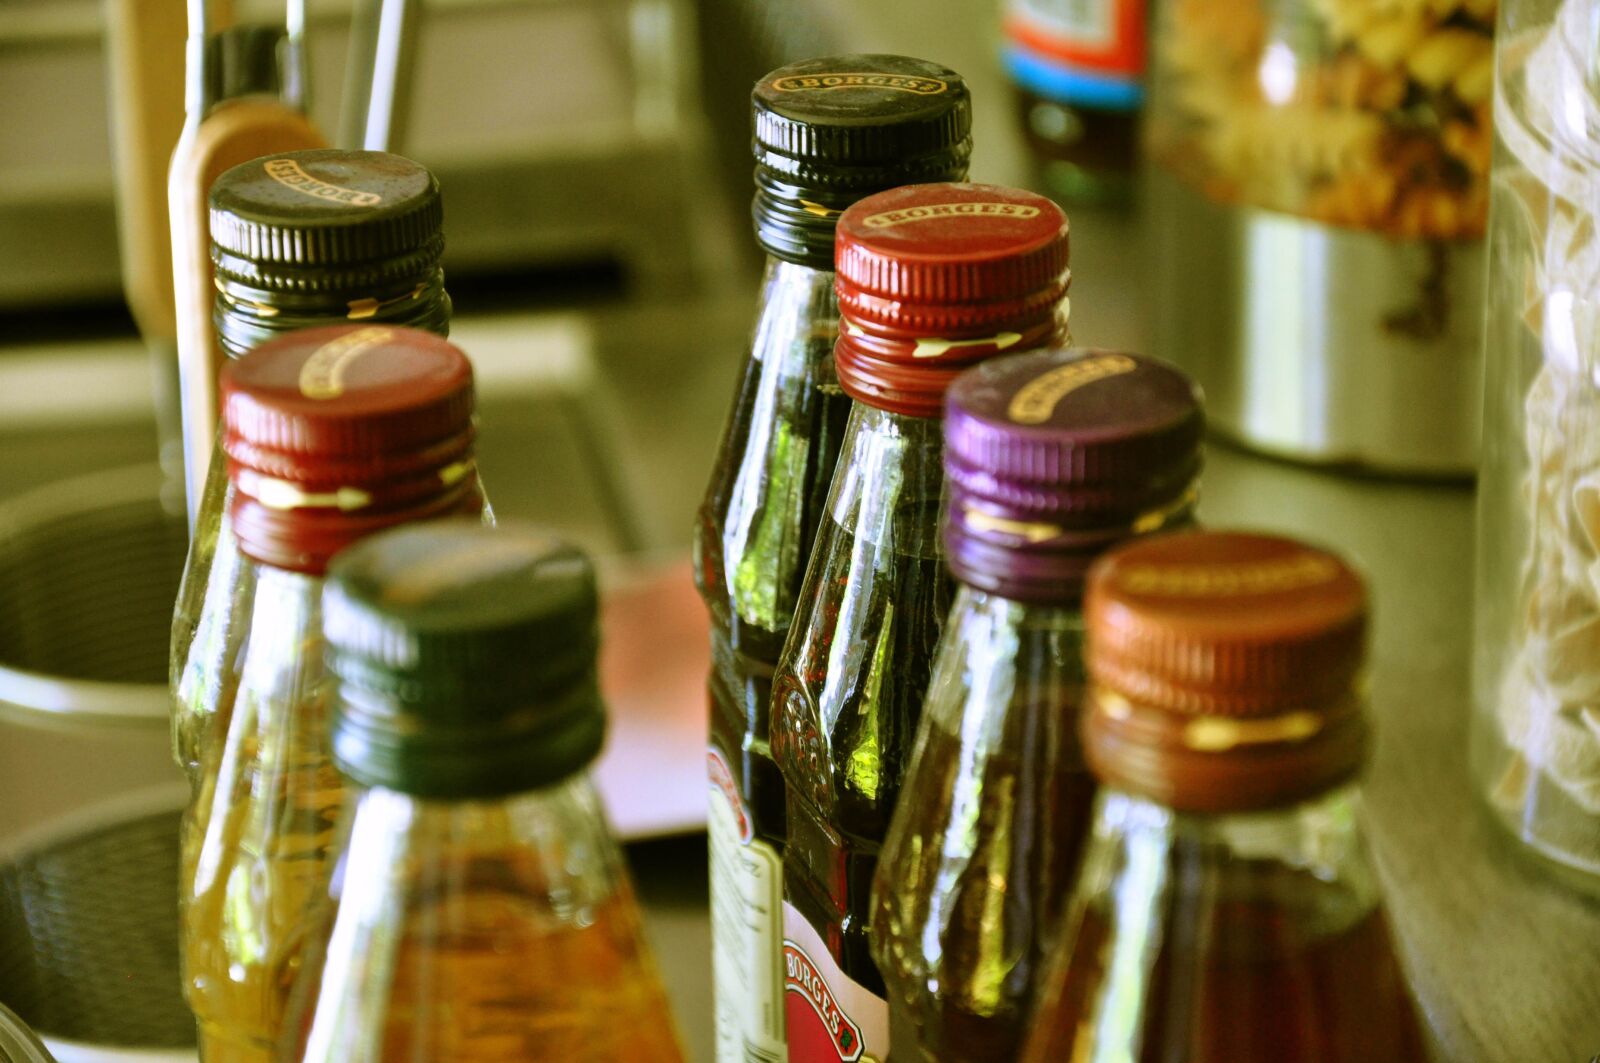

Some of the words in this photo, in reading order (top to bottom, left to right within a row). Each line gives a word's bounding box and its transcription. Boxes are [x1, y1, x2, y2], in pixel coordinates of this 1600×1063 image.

[801, 76, 921, 89] BORGES
[271, 164, 360, 202] BORGES
[885, 204, 1016, 222] BORGES
[786, 952, 840, 1035] BORGES
